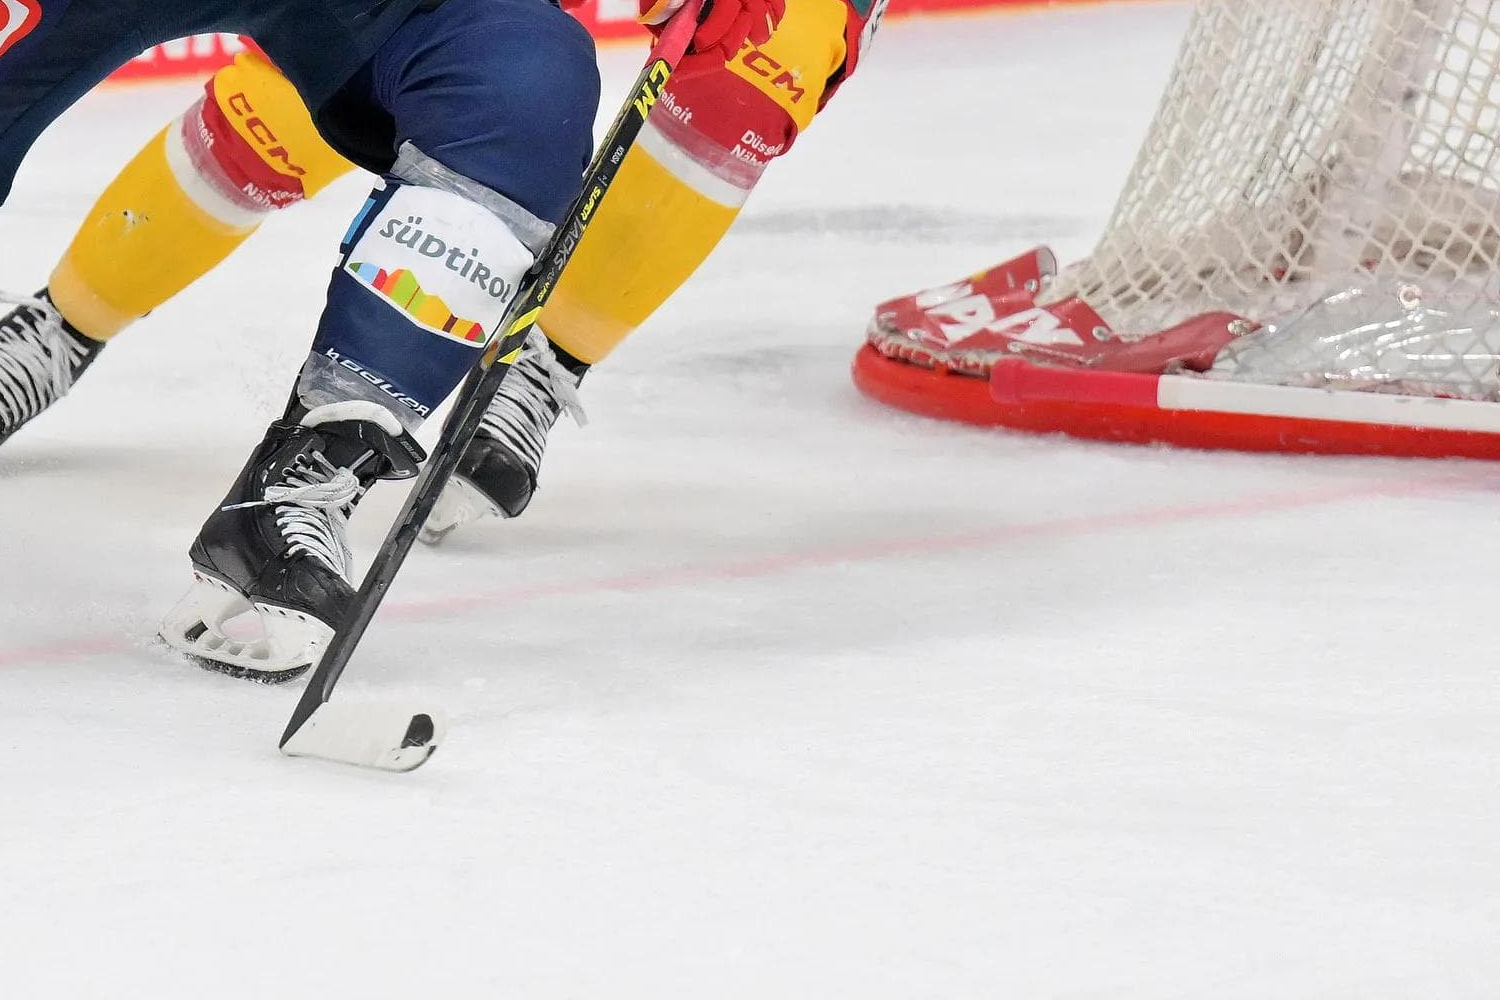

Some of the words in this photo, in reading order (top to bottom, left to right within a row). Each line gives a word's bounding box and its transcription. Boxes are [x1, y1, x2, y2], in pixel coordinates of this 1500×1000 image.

[633, 59, 673, 121] CM
[741, 44, 806, 104] CM
[228, 91, 307, 176] CCM
[580, 185, 602, 222] SUPER
[553, 215, 588, 272] TACKS
